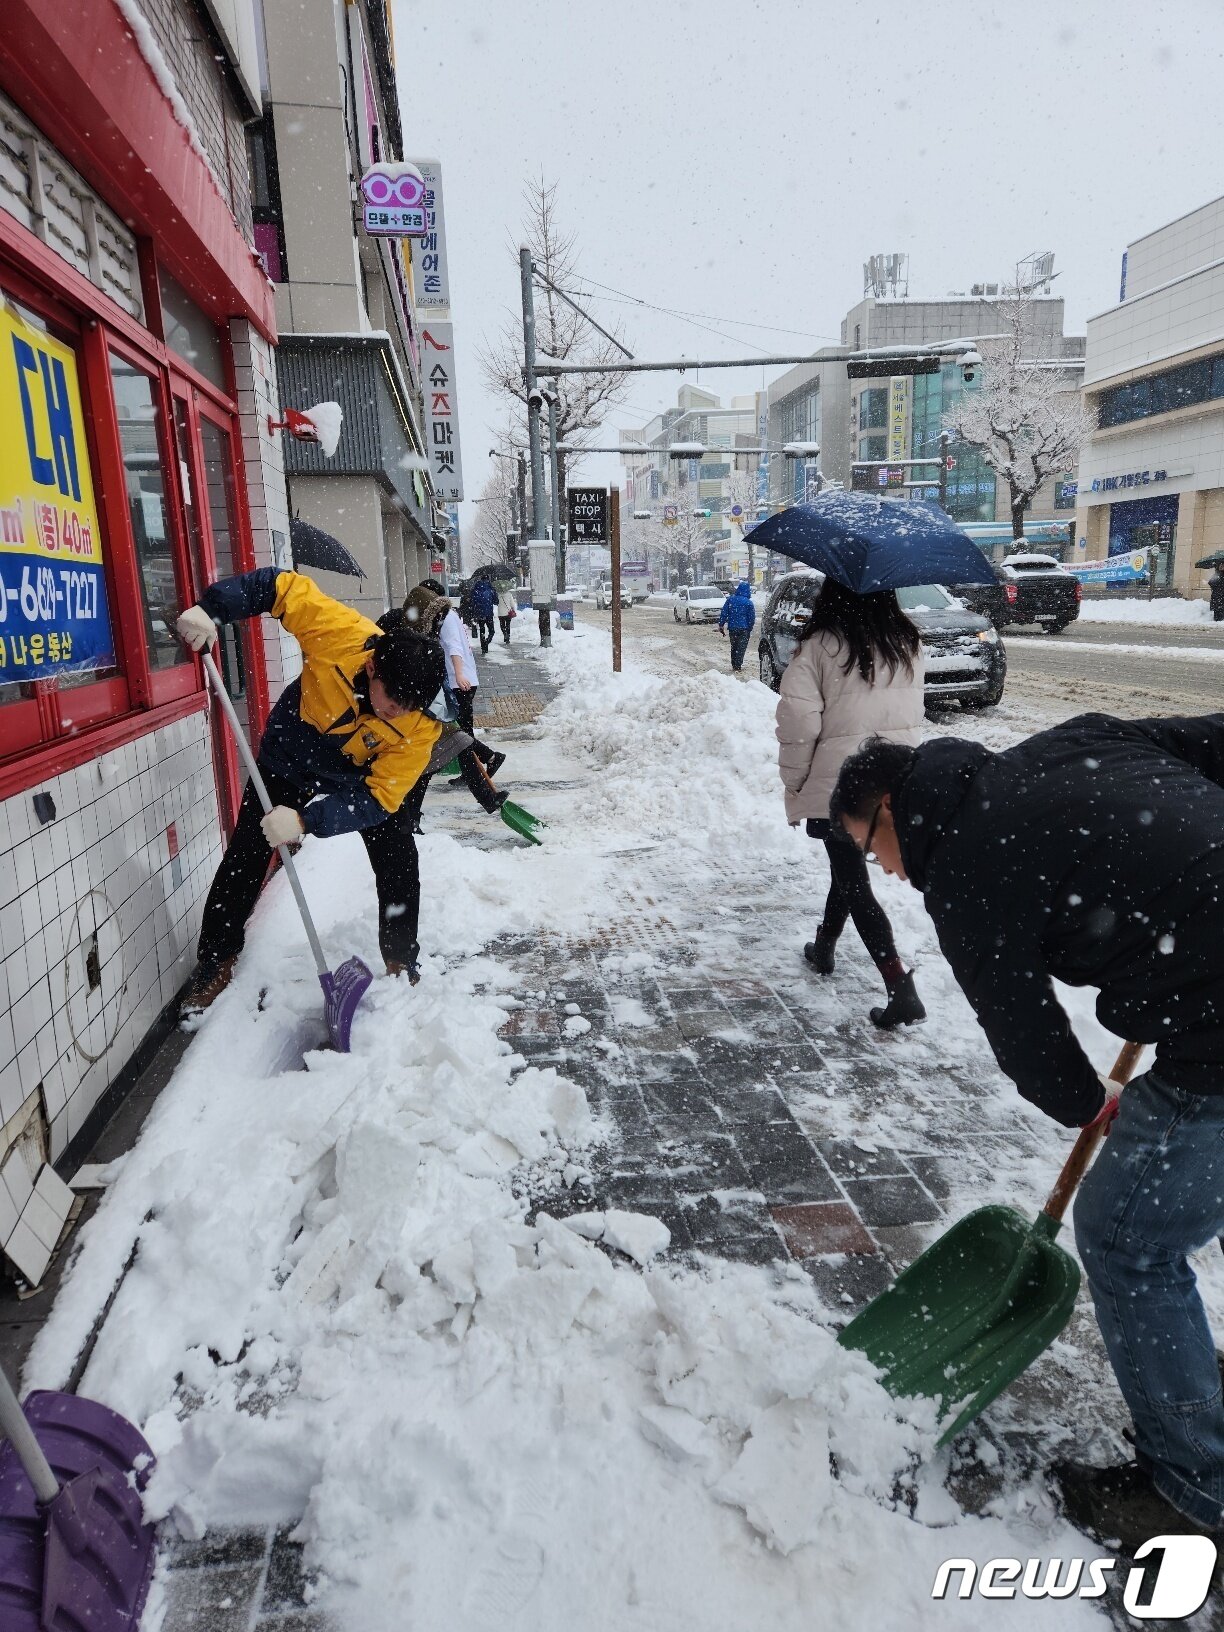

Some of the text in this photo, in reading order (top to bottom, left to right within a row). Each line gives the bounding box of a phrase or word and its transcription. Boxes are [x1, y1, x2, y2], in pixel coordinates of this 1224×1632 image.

[11, 330, 81, 503] 대
[429, 363, 455, 474] 슈즈마켓
[574, 493, 599, 503] TAXI
[574, 505, 601, 516] STOP
